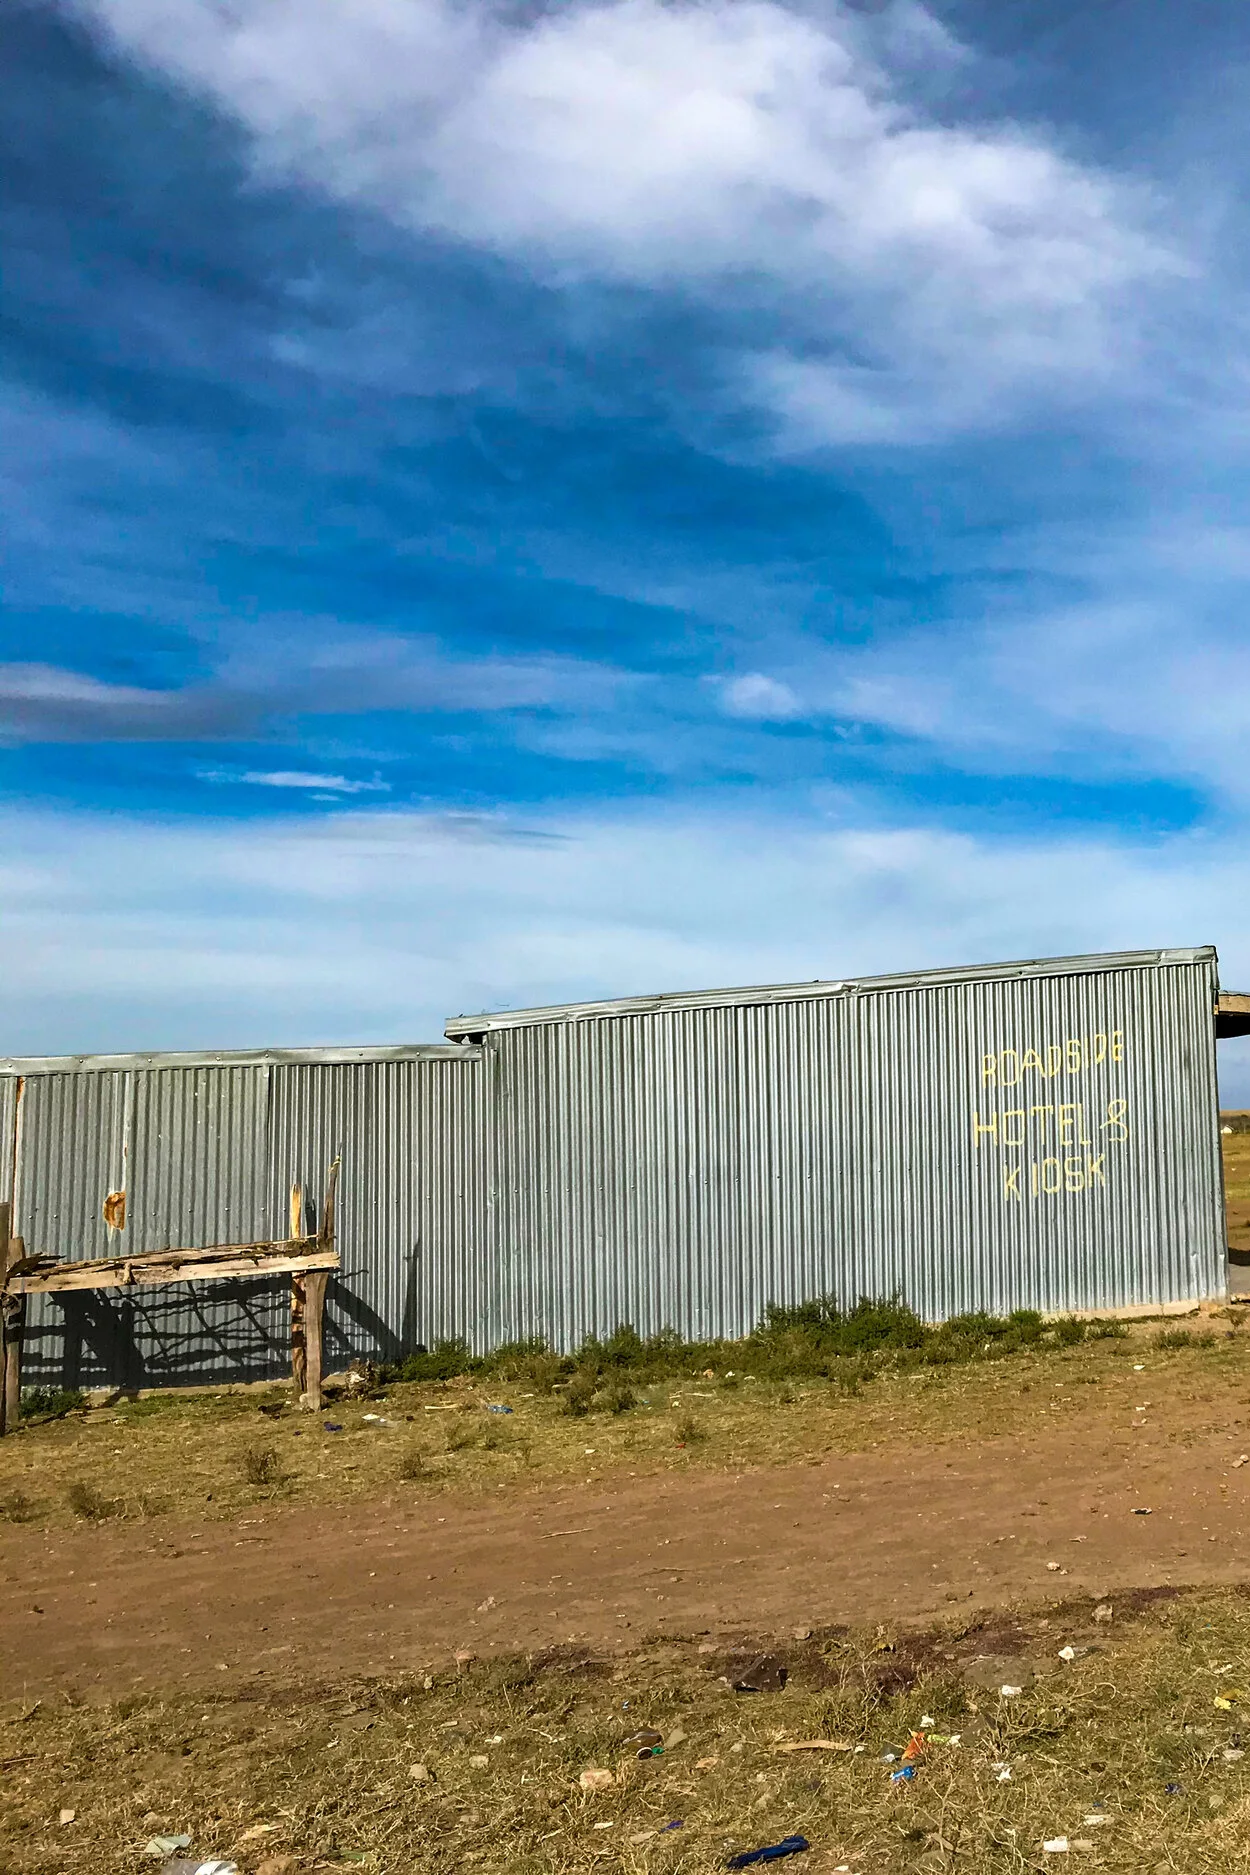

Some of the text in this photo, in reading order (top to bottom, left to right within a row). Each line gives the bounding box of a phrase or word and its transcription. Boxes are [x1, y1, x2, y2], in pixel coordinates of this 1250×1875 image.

[982, 1030, 1124, 1089] ROADSIDE
[973, 1103, 1092, 1148] HOTEL
[1003, 1152, 1106, 1201] KIOSK
